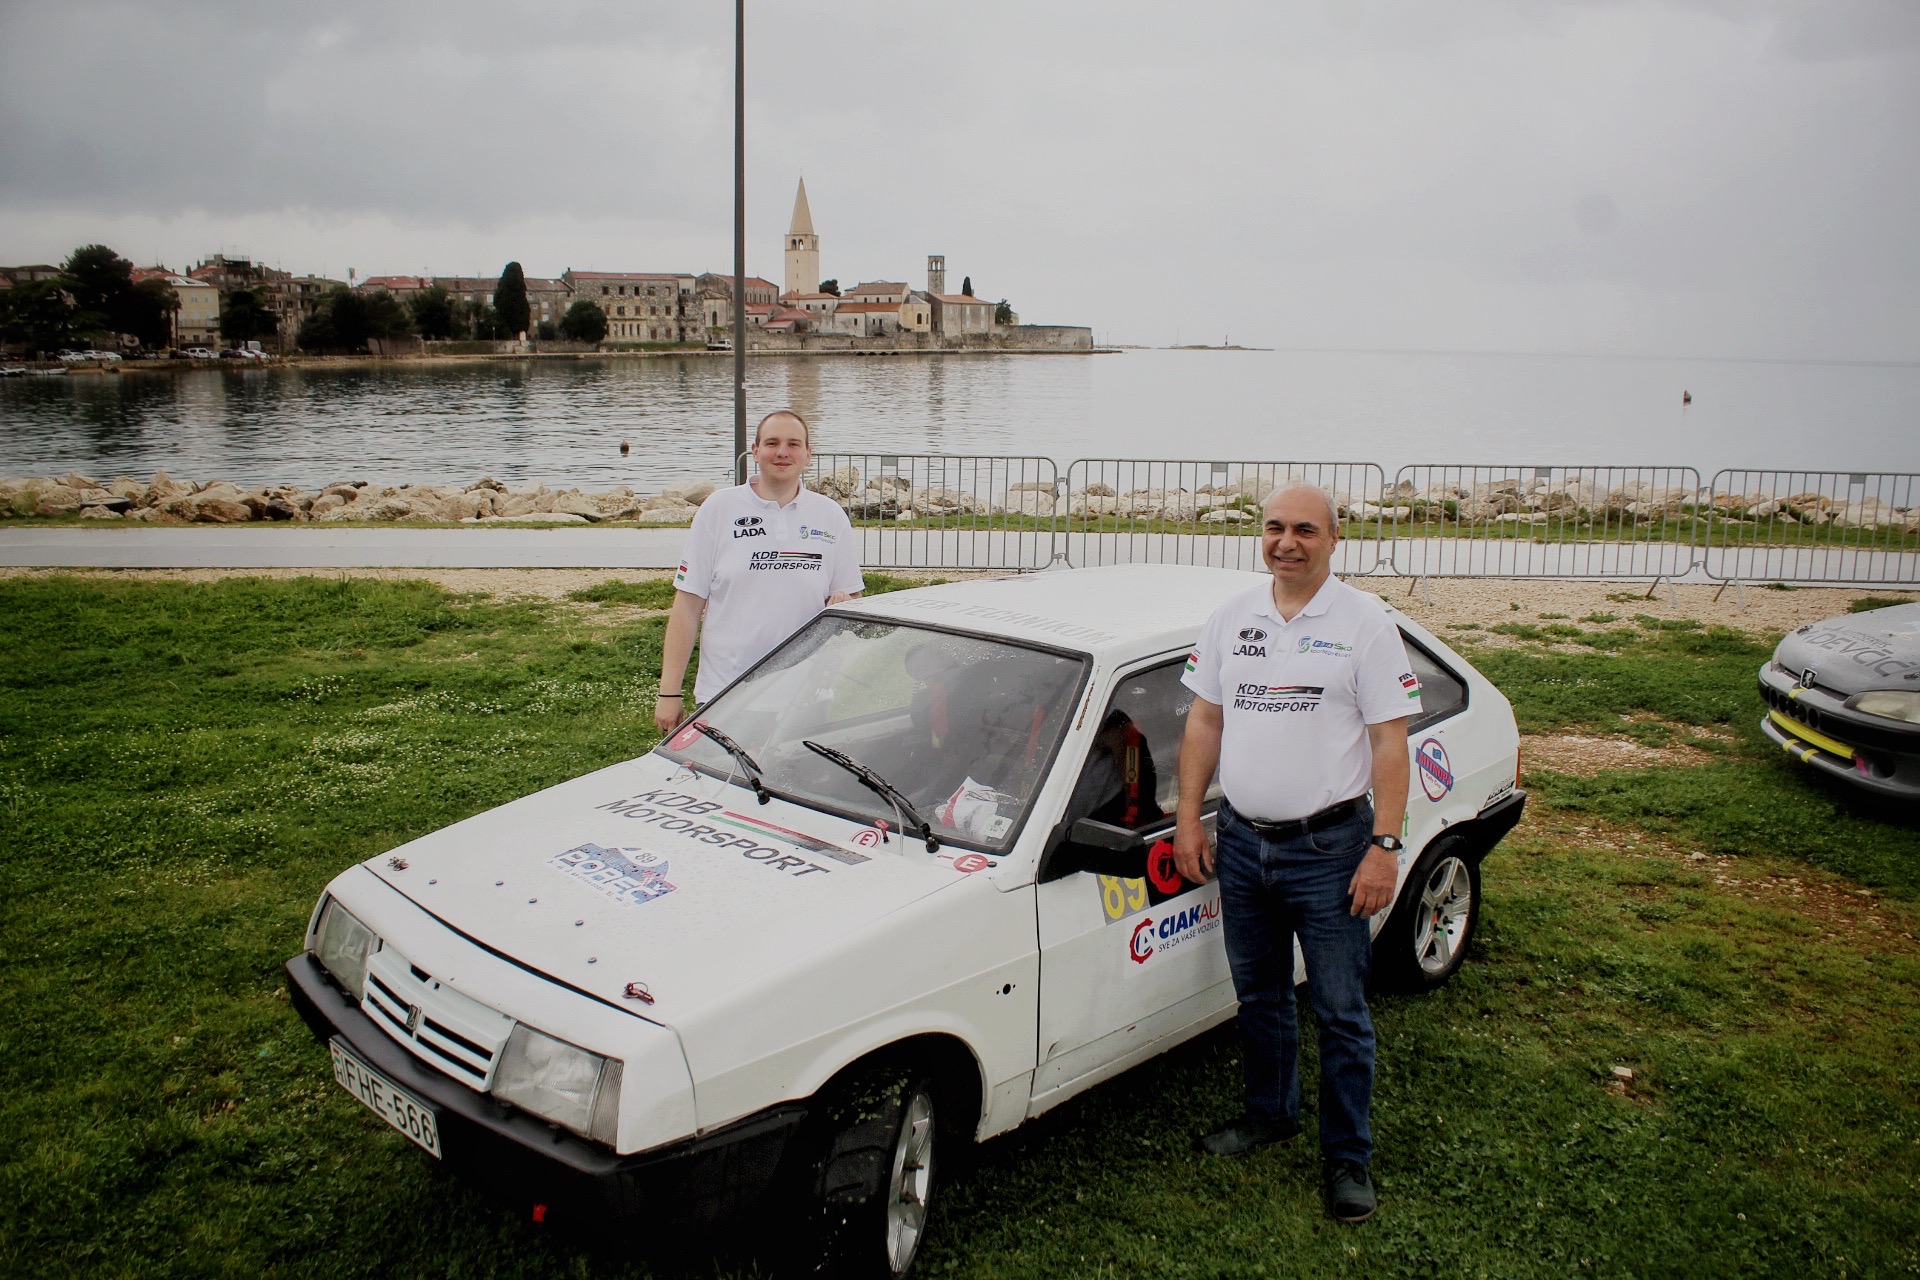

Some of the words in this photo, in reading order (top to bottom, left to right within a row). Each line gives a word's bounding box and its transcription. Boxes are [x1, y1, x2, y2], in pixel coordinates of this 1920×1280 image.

[733, 527, 767, 539] LADA
[751, 551, 779, 560] KDB
[749, 562, 822, 572] MOTORSPORT
[1232, 644, 1267, 658] LADA
[1236, 683, 1268, 696] KDB
[1233, 699, 1320, 712] MOTORSPORT
[632, 789, 724, 816] KDB
[594, 799, 832, 878] MOTORSPORT
[858, 833, 874, 847] E
[959, 858, 982, 872] E
[1100, 874, 1146, 920] 89
[1159, 896, 1221, 940] CIAKAU
[1158, 940, 1171, 953] SVE
[1171, 937, 1180, 948] ZA
[1180, 929, 1196, 944] VAŠE
[1197, 919, 1220, 936] VOZILO
[344, 1058, 435, 1149] FHE-566
